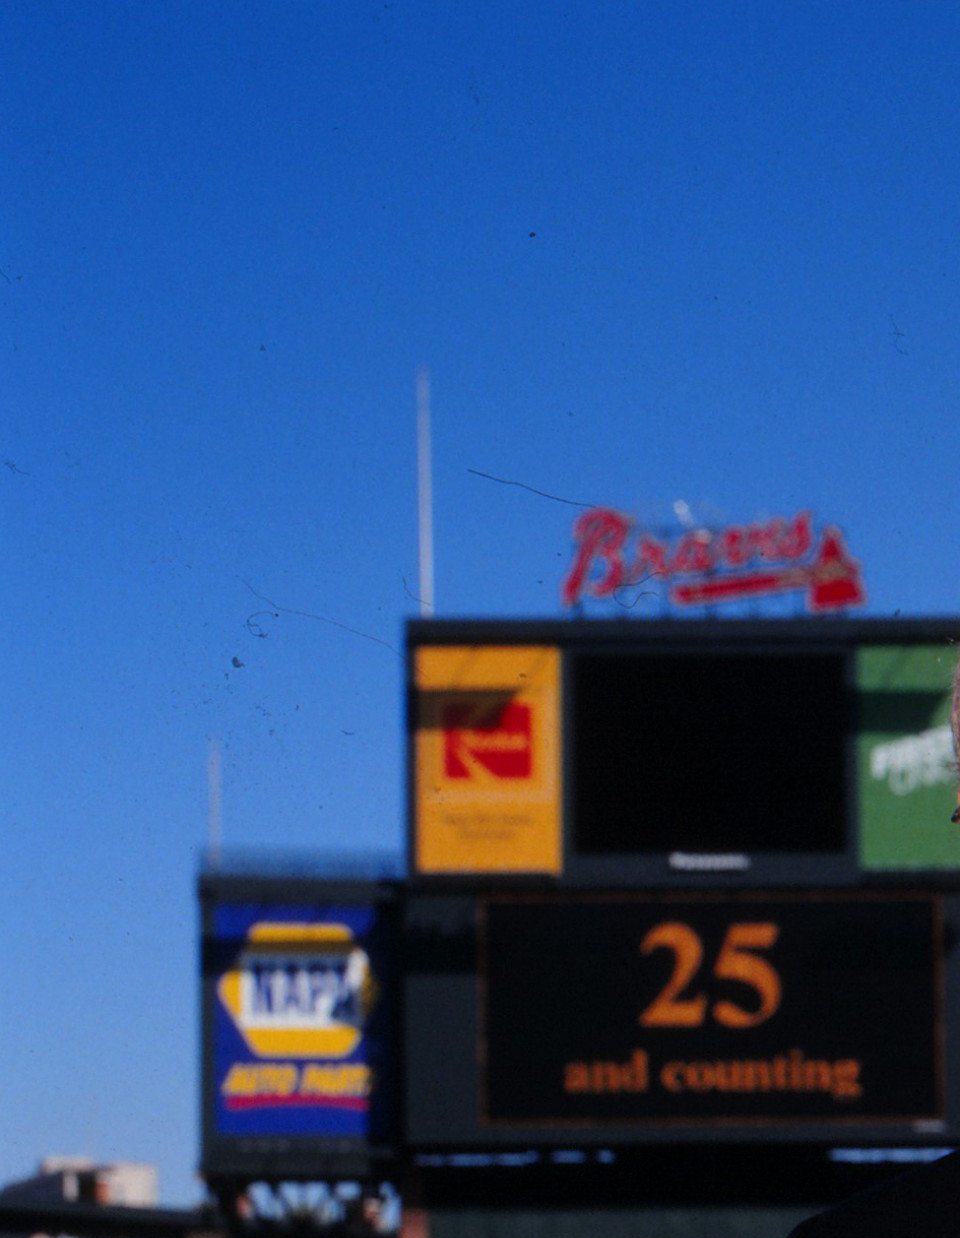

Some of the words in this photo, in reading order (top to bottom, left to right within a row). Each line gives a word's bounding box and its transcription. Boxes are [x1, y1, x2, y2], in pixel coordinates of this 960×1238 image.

[638, 920, 783, 1028] 25
[564, 1049, 649, 1095] and
[660, 1048, 864, 1102] counting
